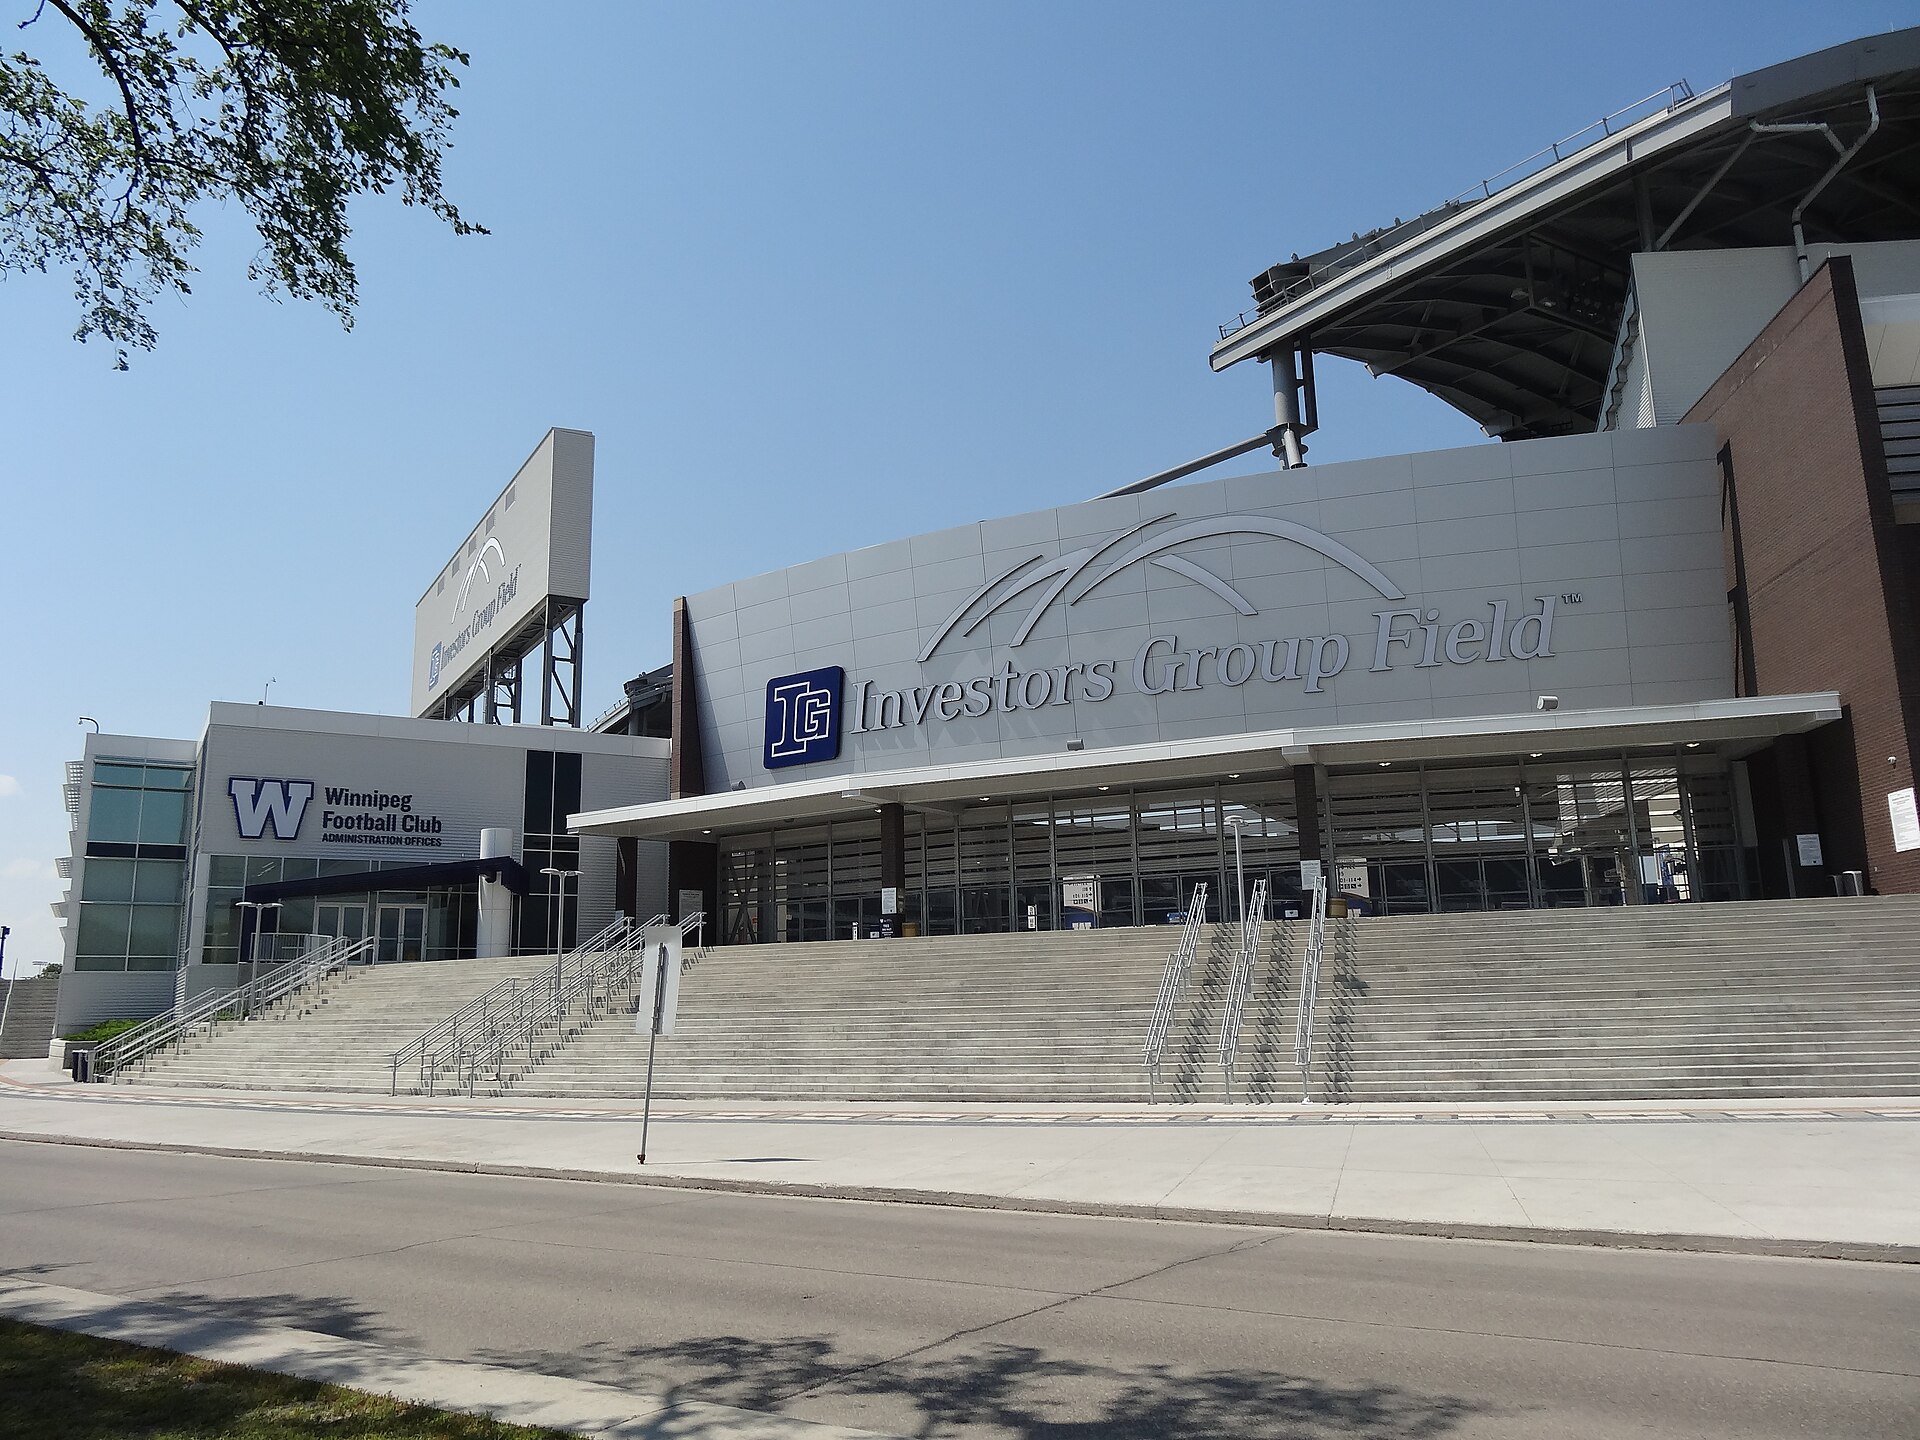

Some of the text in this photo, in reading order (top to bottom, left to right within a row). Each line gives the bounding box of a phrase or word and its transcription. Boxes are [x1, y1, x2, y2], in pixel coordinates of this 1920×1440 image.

[850, 658, 1117, 735] Investors
[1132, 633, 1349, 696] Group
[1369, 594, 1556, 672] Field
[228, 777, 314, 840] W
[325, 786, 412, 812] Winnipeg
[322, 811, 442, 833] Football Club
[321, 832, 443, 847] ADMINISTRATION OFFICES
